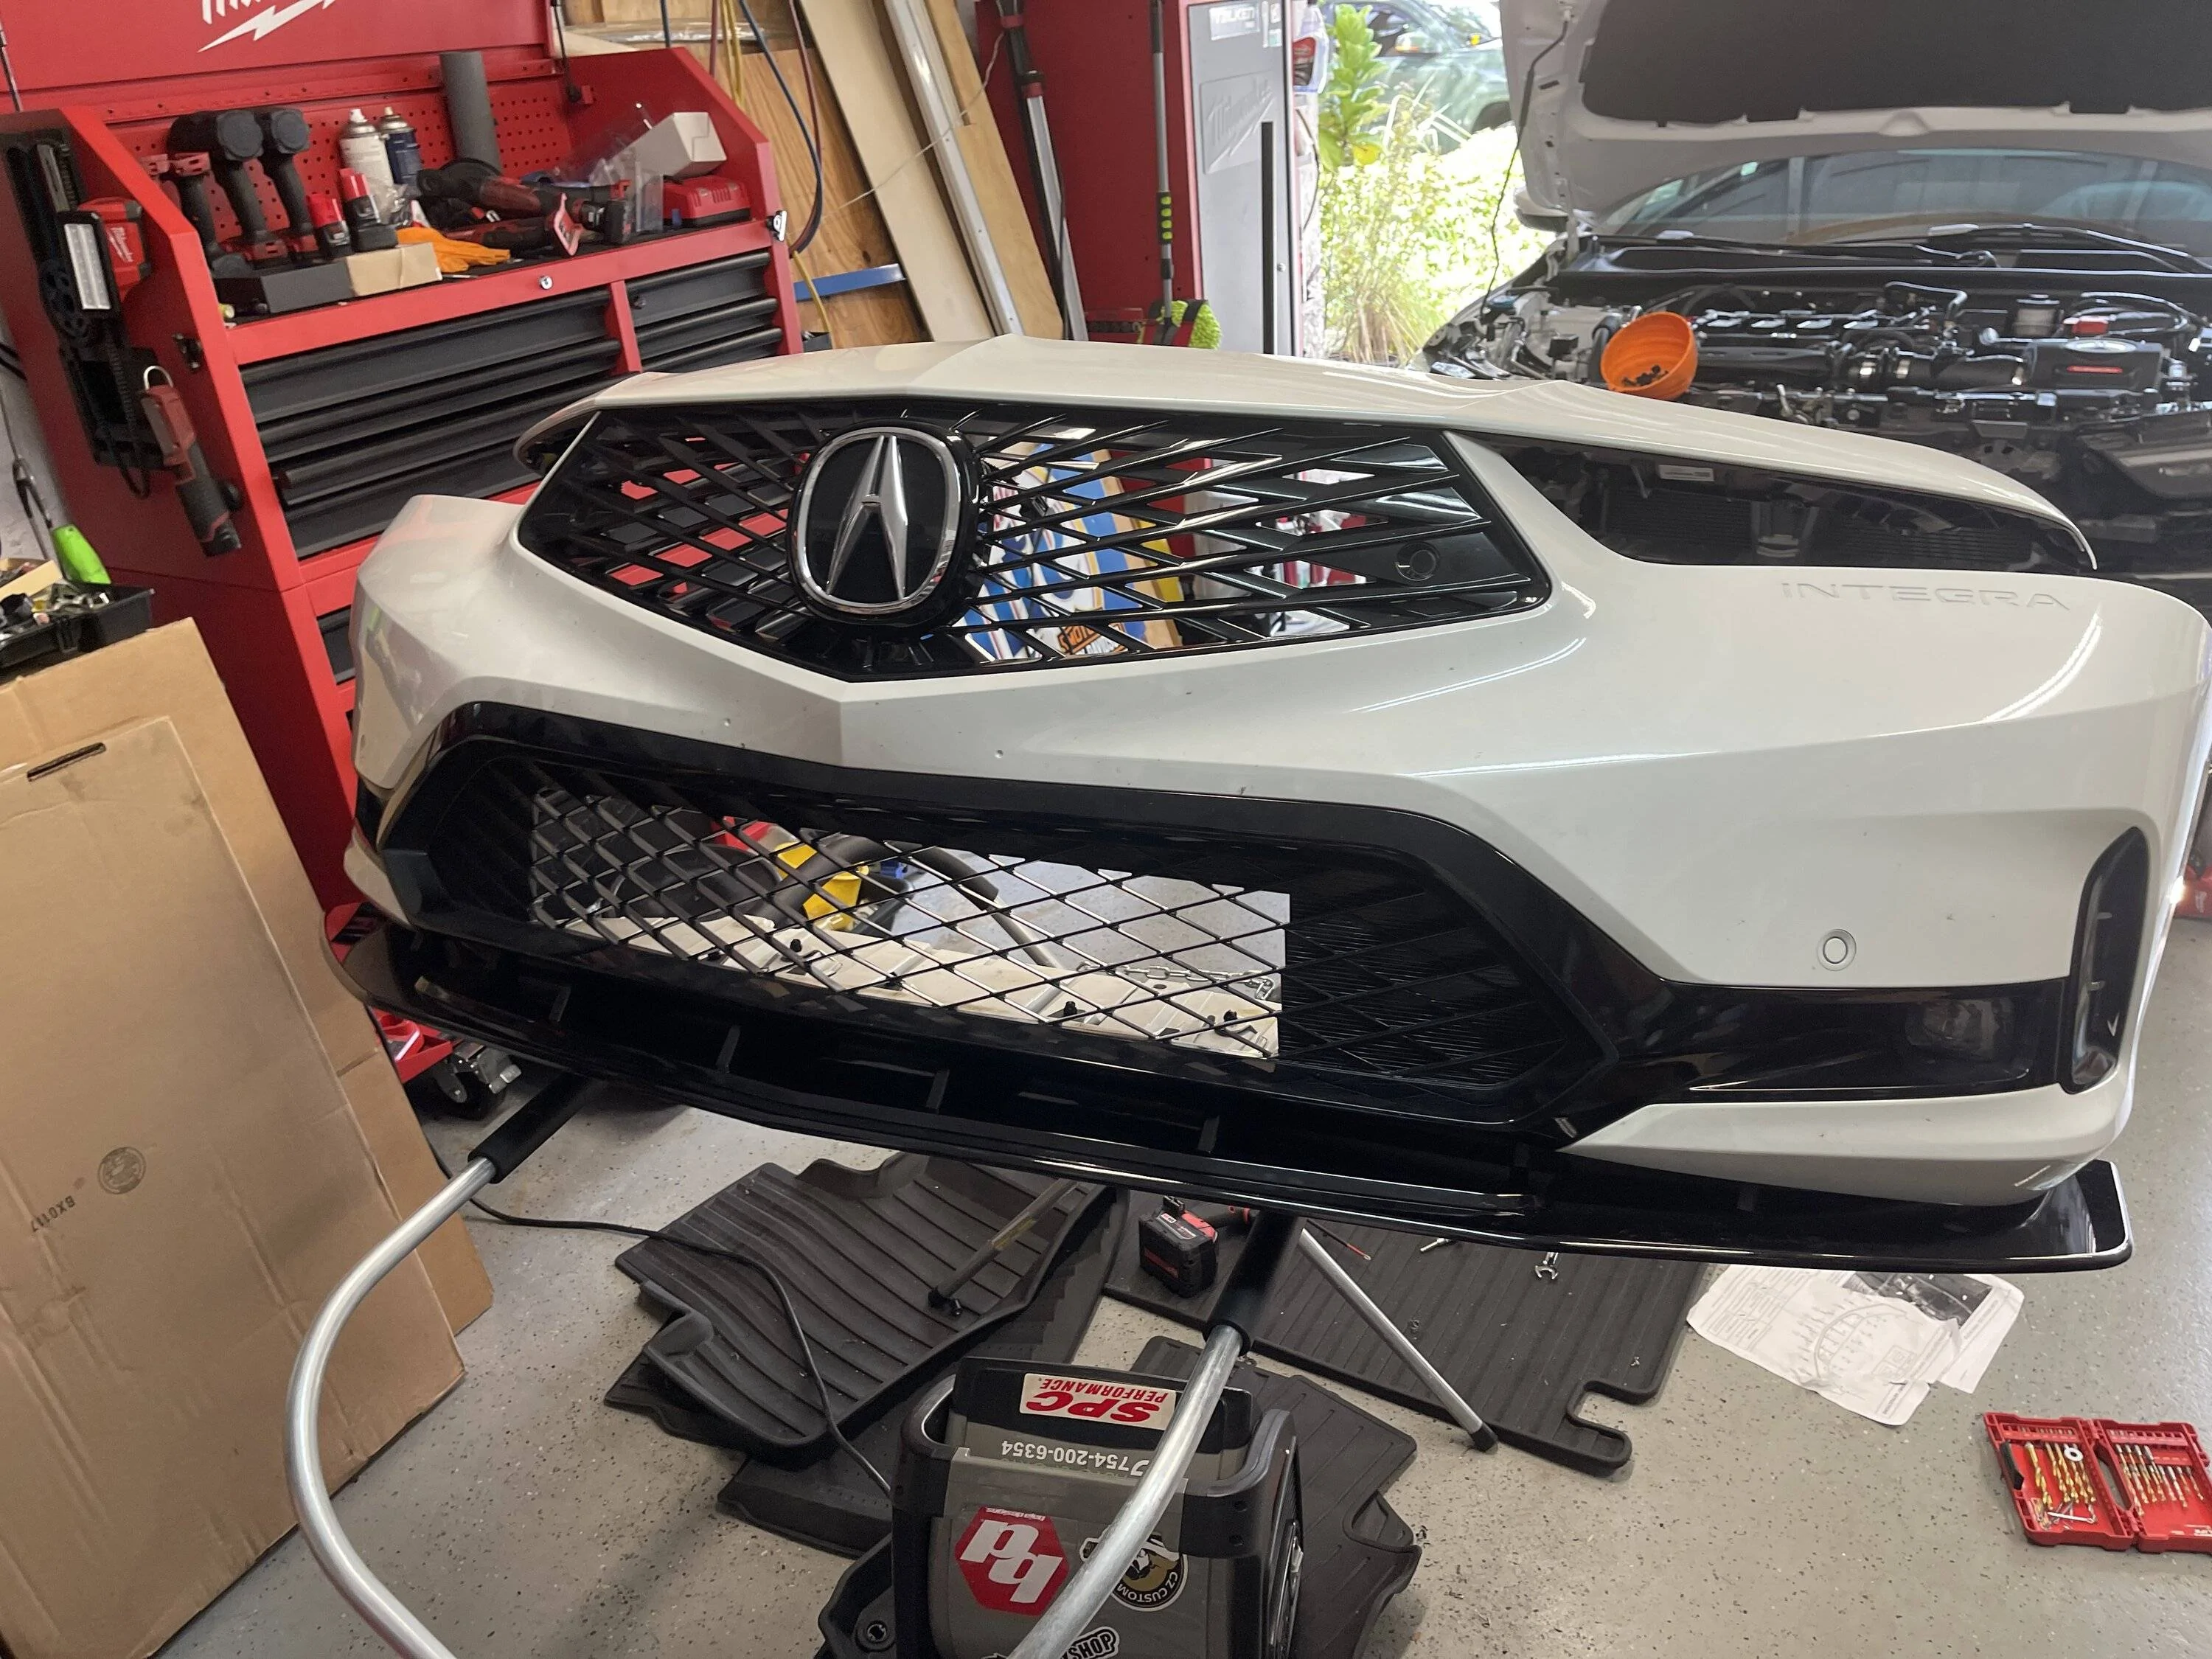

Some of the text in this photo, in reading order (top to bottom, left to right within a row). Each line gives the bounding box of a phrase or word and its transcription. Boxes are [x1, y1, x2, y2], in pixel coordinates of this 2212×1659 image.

[1781, 582, 2070, 611] INTEGRA
[1040, 1378, 1169, 1402] PERFORMANCE
[1026, 1391, 1160, 1422] SPC
[1001, 1440, 1130, 1471] 754-200-6354
[1117, 1571, 1178, 1603] CZ CUSTOM
